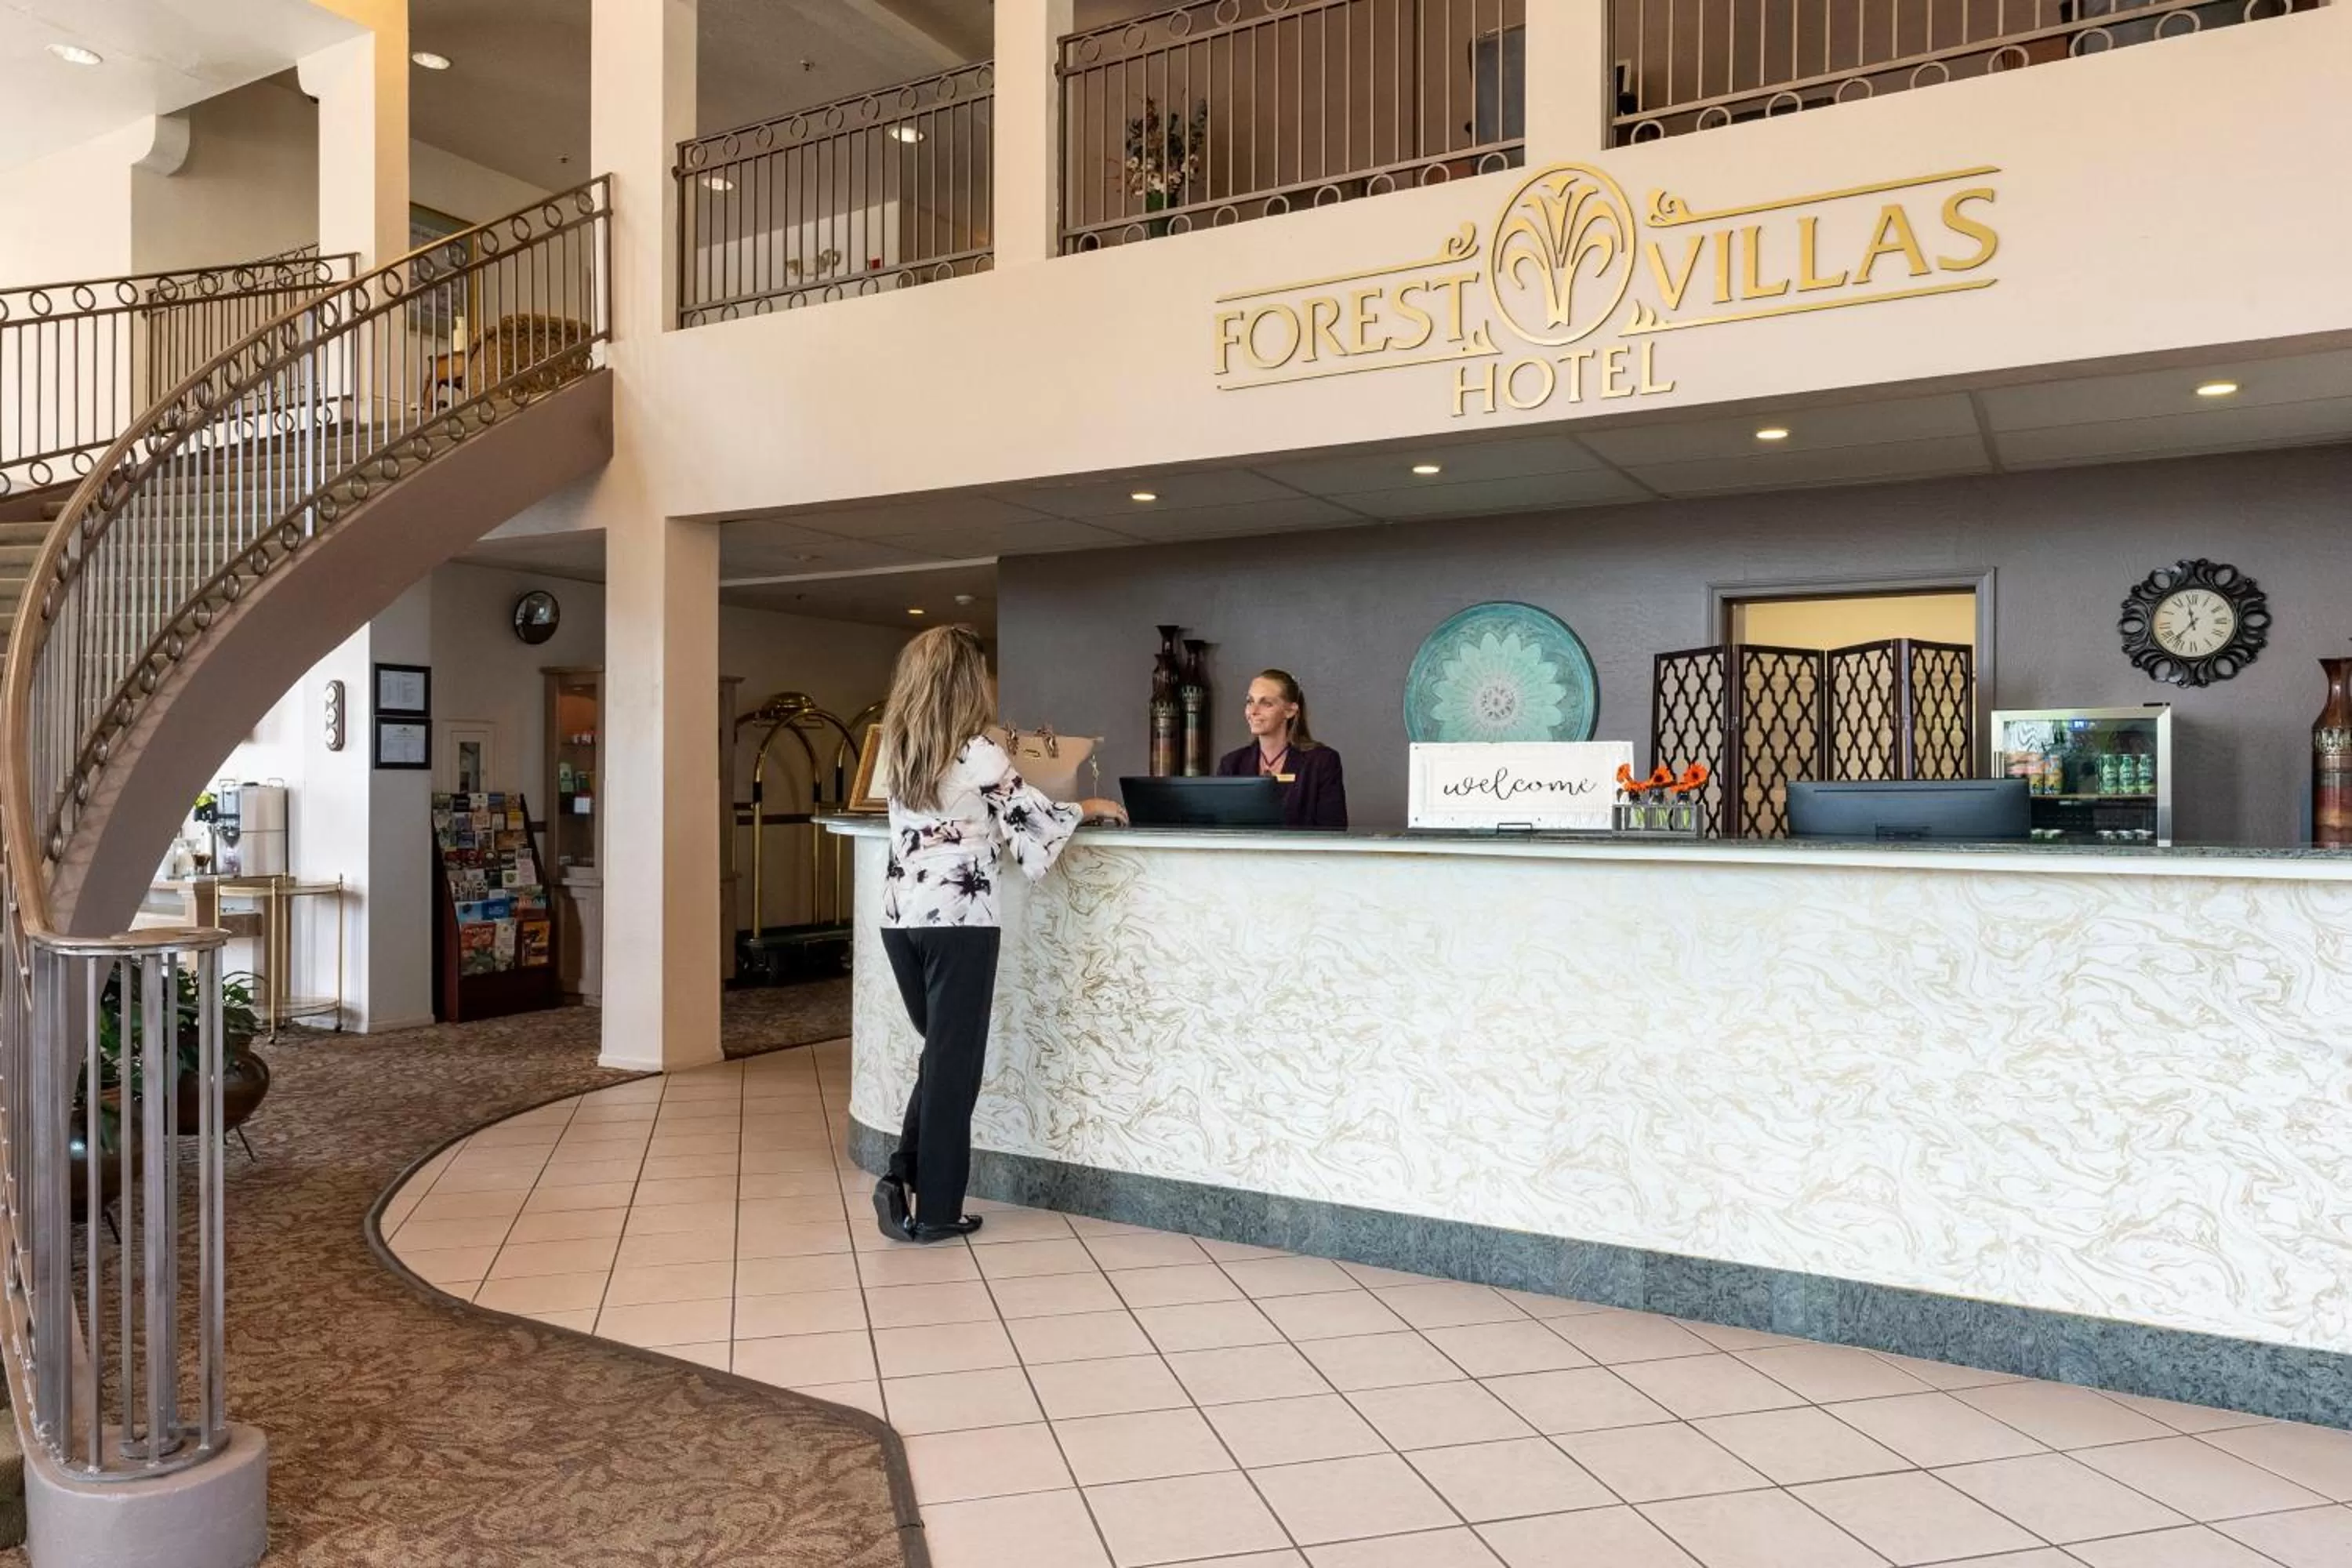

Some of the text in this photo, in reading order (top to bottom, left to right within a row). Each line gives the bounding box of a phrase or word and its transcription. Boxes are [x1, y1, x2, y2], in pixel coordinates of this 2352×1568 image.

[1214, 187, 1998, 375] FOREST VILLAS
[1453, 342, 1675, 418] HOTEL
[1443, 767, 1596, 800] welcome
